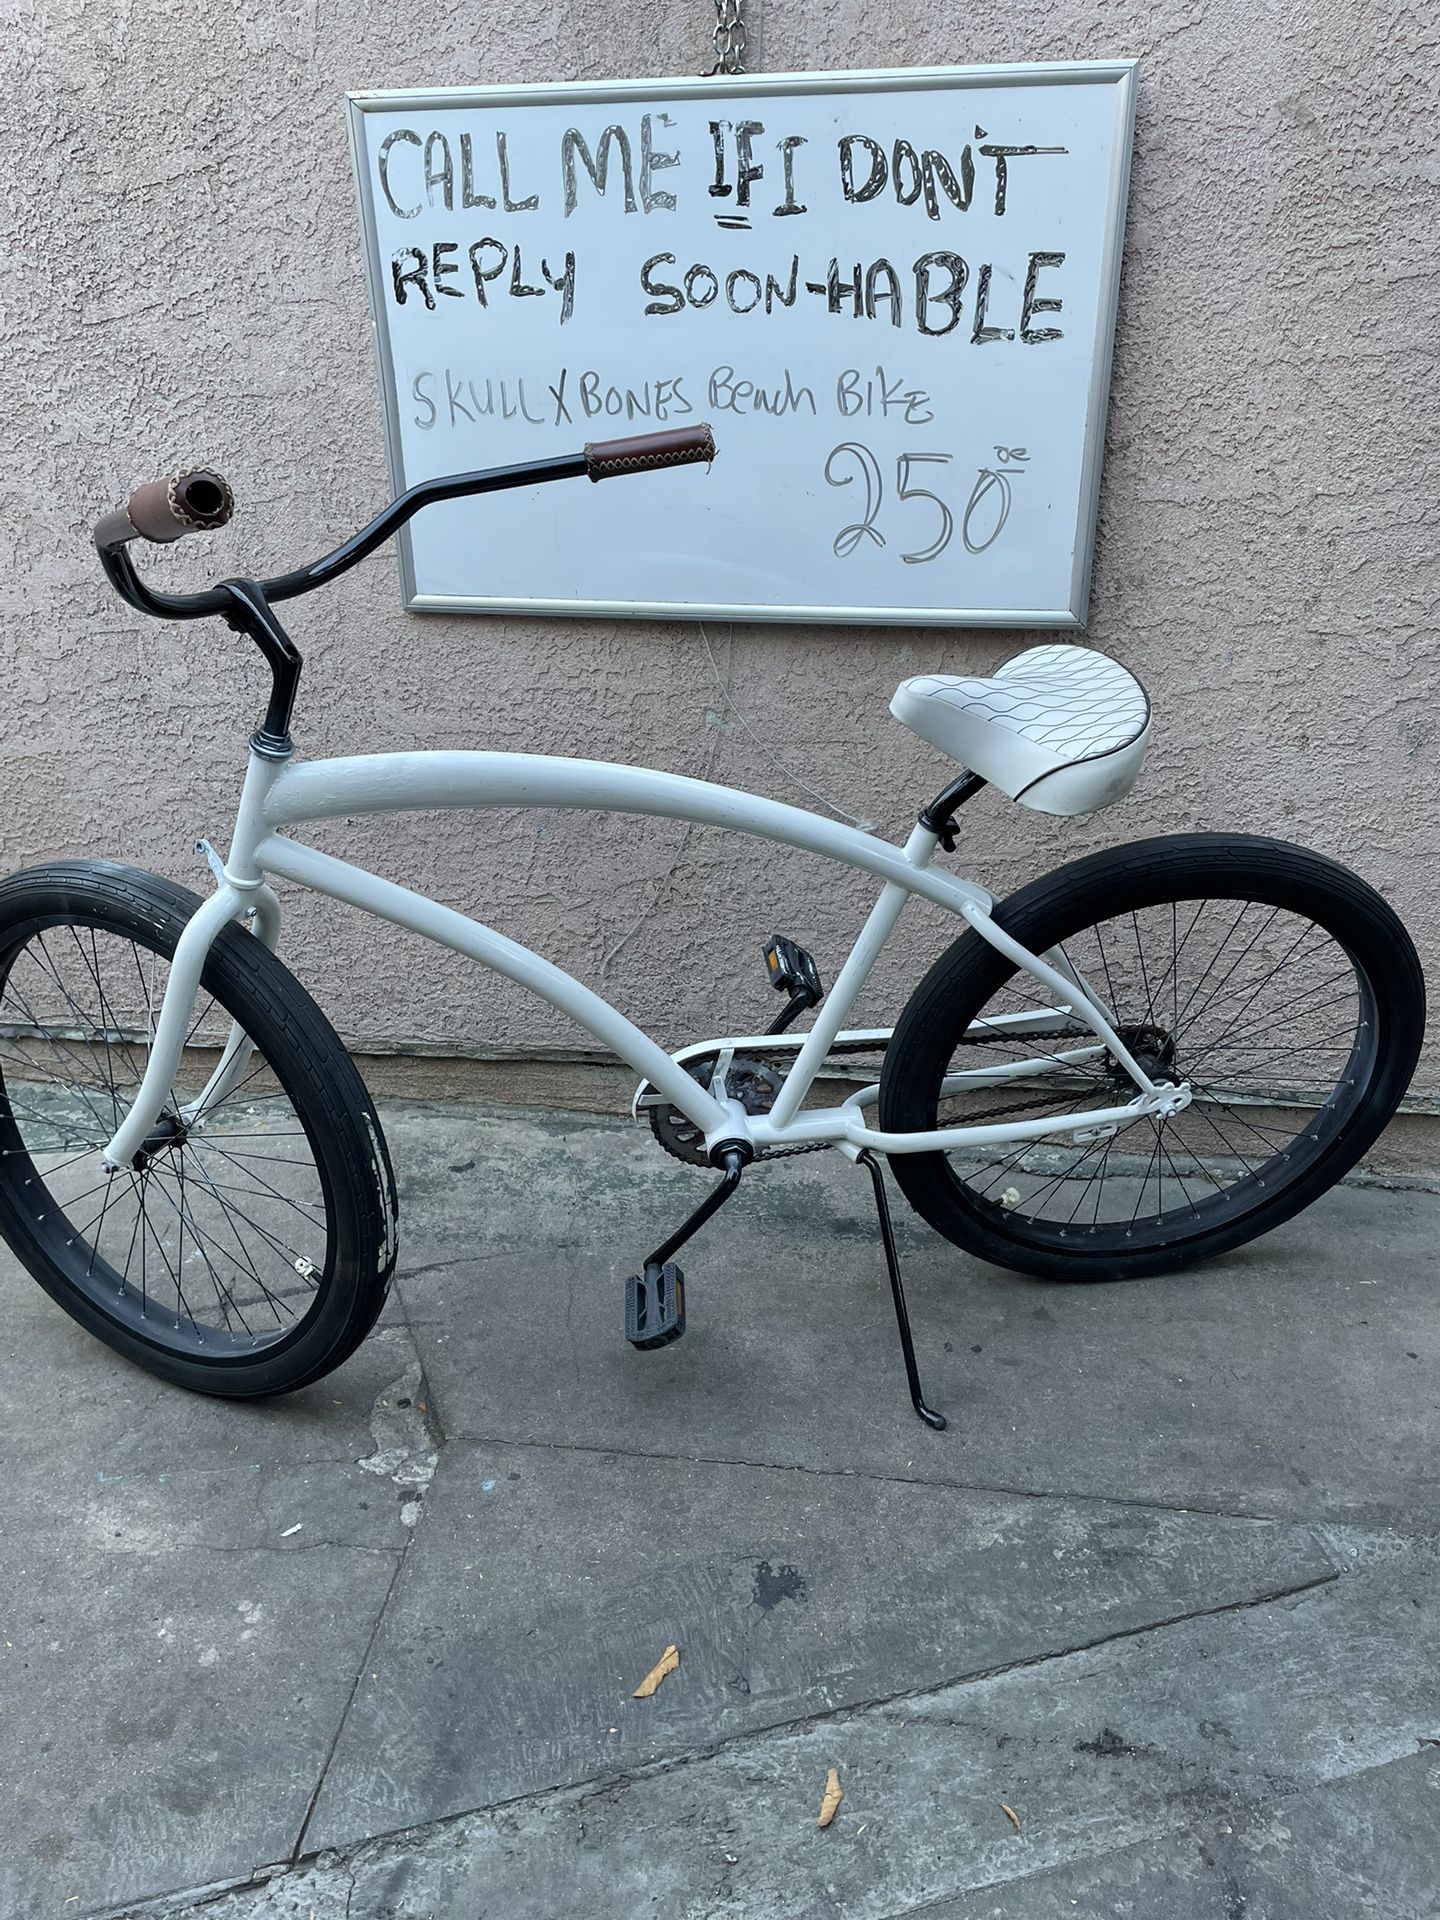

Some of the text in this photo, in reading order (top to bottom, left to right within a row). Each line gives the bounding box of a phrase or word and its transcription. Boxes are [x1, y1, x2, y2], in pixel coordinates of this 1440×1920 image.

[378, 113, 1070, 222] CALL ME IF I DON'T
[412, 368, 545, 430] SKULL
[549, 367, 573, 427] X
[580, 370, 693, 422] BONES
